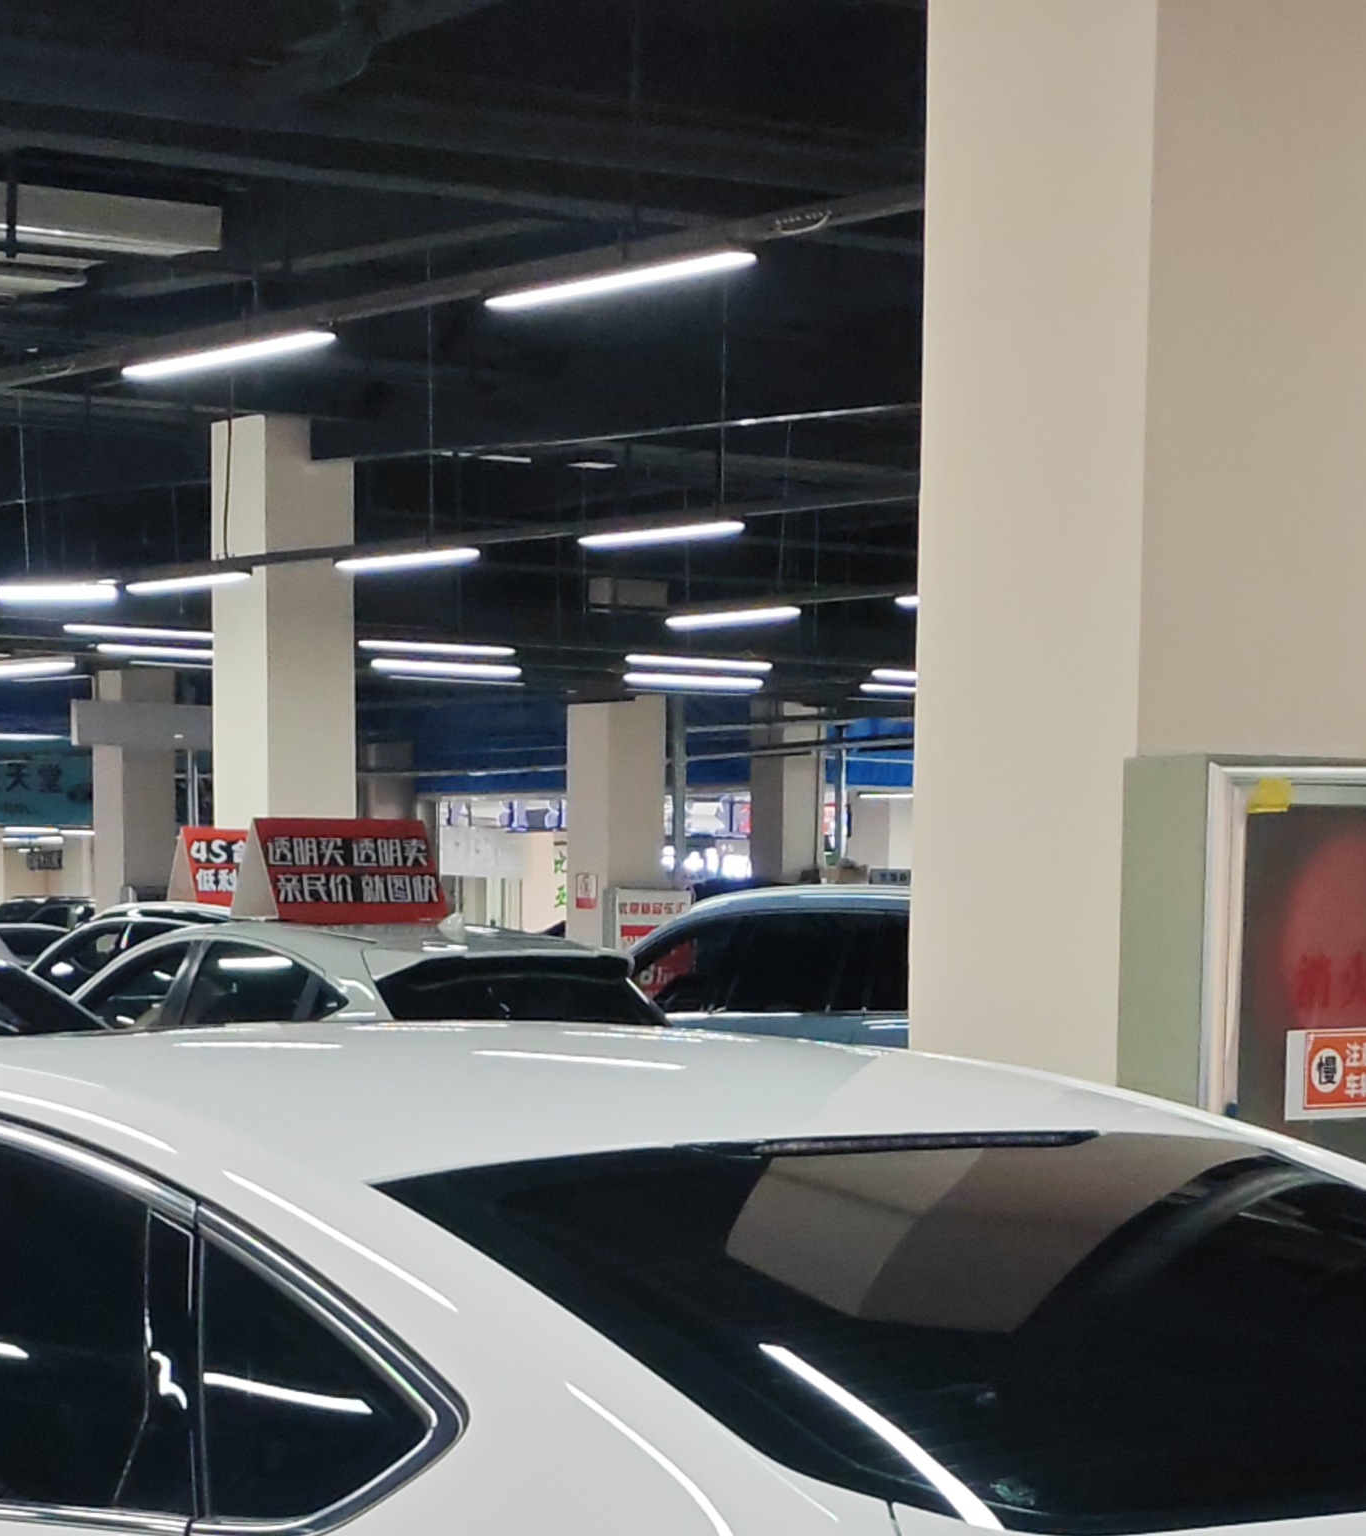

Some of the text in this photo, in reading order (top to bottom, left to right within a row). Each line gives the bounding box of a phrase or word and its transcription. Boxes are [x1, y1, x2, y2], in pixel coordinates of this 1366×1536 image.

[267, 837, 428, 867] 透明买 透明卖
[277, 874, 439, 902] 亲民价 就图快
[1316, 1056, 1337, 1085] 慢
